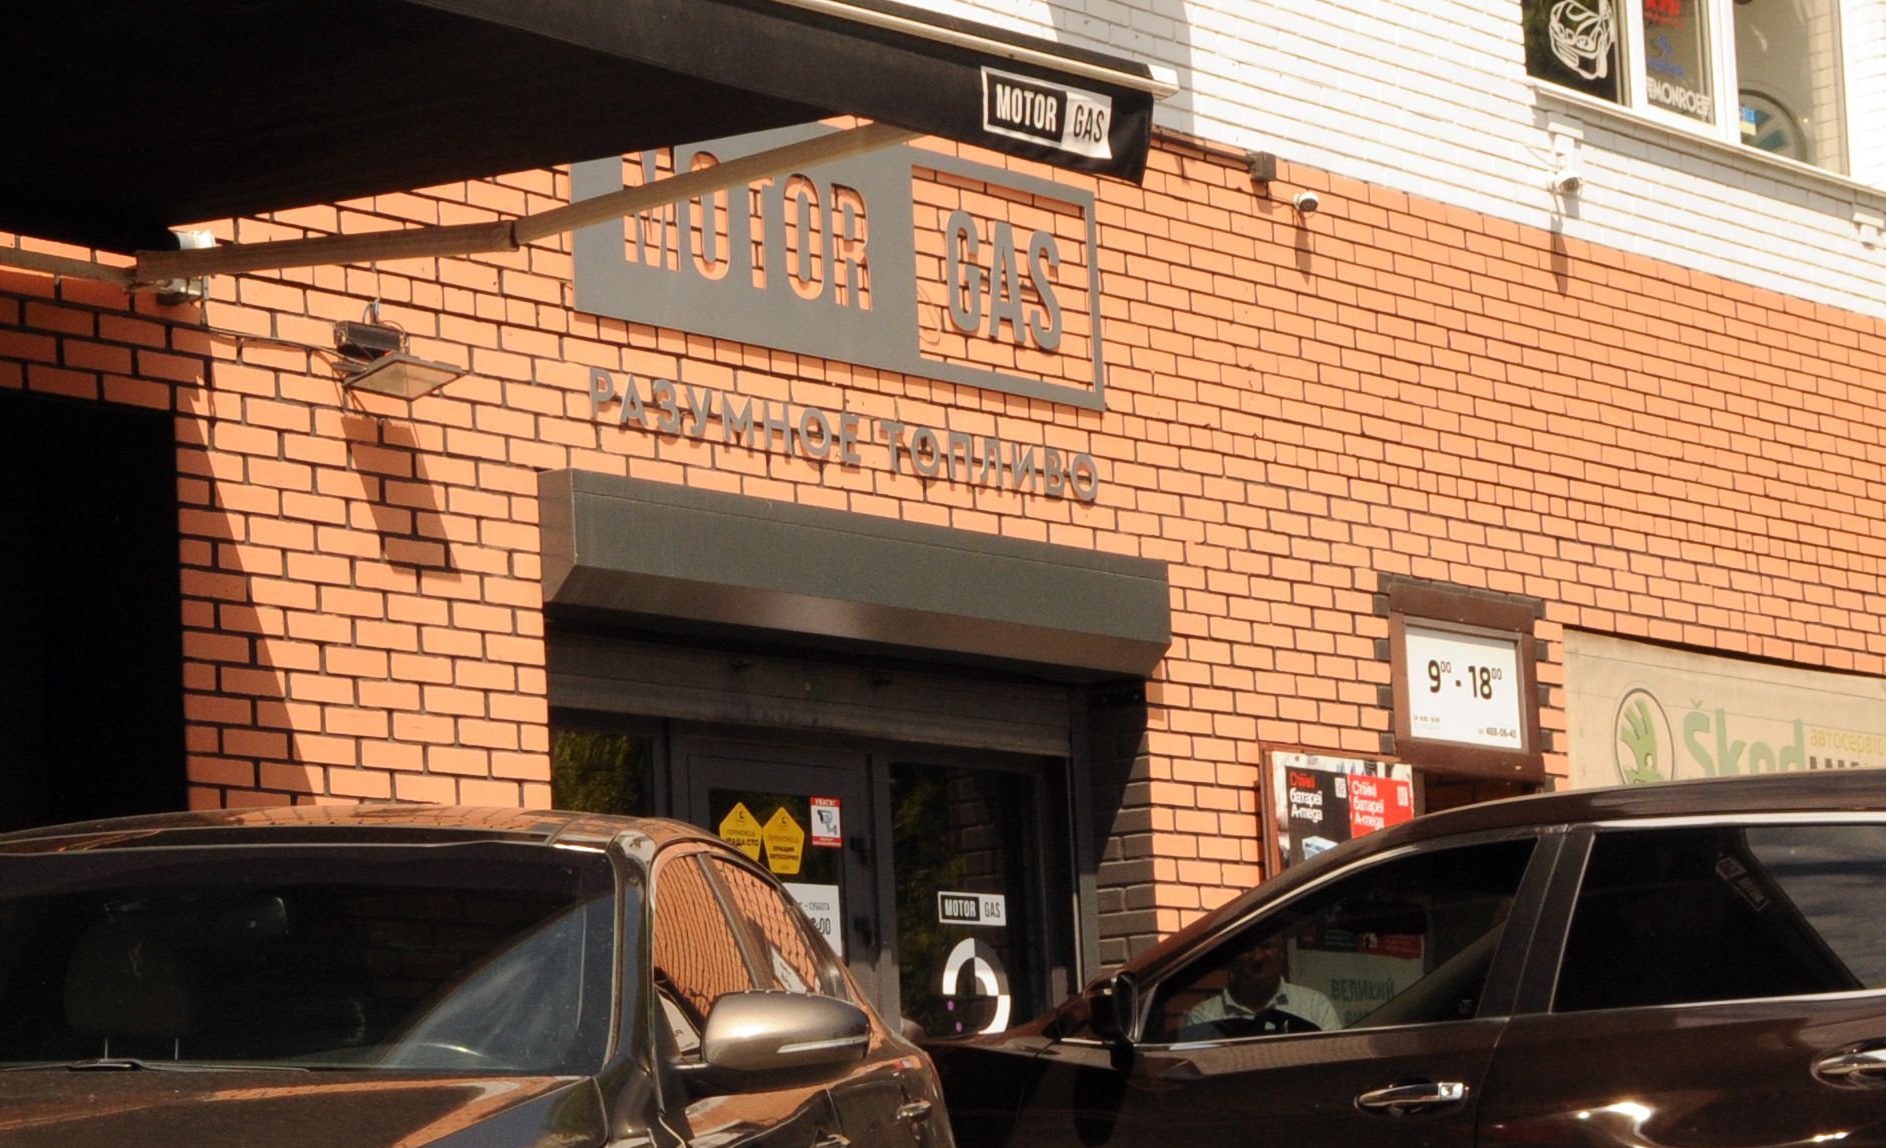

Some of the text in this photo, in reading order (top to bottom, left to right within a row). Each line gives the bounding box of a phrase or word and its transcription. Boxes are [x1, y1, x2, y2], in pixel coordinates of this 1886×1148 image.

[995, 83, 1104, 143] MOTOR GAS
[1654, 79, 1704, 115] MONROE
[621, 146, 1062, 351] MOTOR GAS
[588, 366, 1100, 501] РАЗУМНОЕ ТОПЛИВО
[944, 898, 1001, 919] MOTOR GAS
